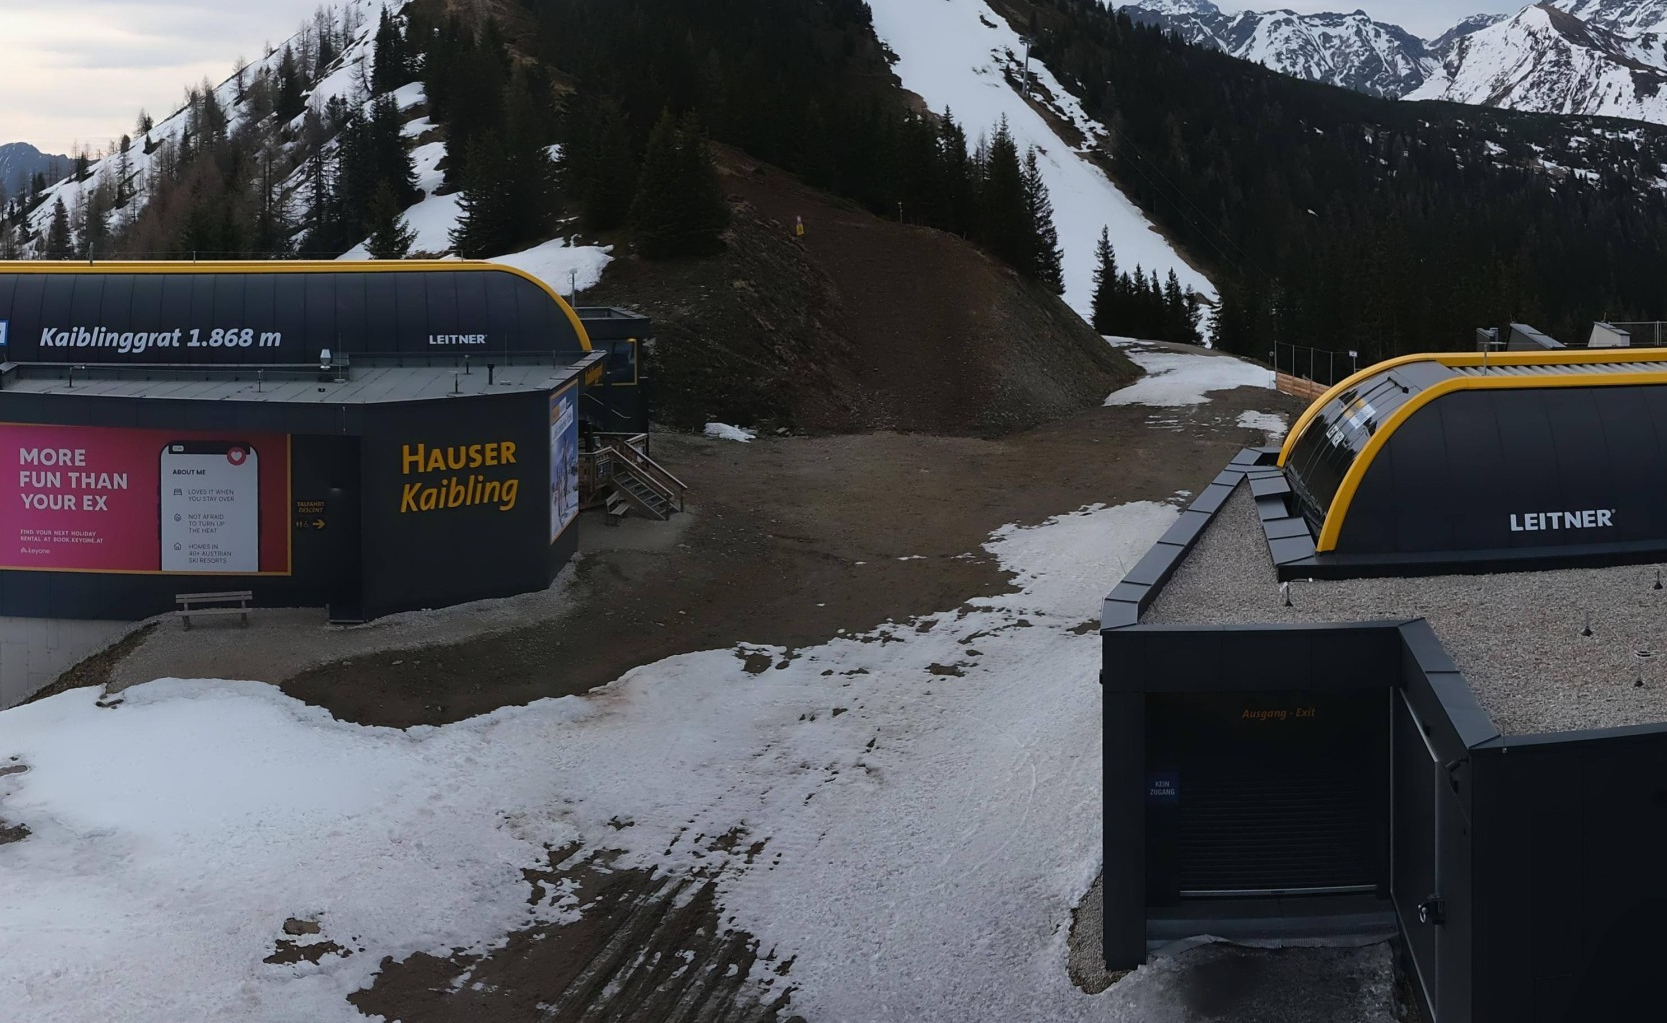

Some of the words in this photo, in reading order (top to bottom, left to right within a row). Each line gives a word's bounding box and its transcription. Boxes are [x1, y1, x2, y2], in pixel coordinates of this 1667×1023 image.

[39, 327, 182, 353] Kaiblinggrat
[187, 328, 253, 348] 1.868
[259, 331, 282, 347] m
[20, 448, 86, 466] MORE
[402, 441, 516, 475] HAUSER
[20, 471, 61, 488] FUN
[68, 472, 128, 489] THAN
[20, 493, 76, 510] YOUR
[83, 495, 108, 511] EX
[400, 475, 519, 513] Kaibling
[28, 547, 51, 555] keyone
[1242, 709, 1287, 721] Ausgang
[1295, 707, 1315, 718] Exit
[1150, 788, 1175, 796] ZUGANG
